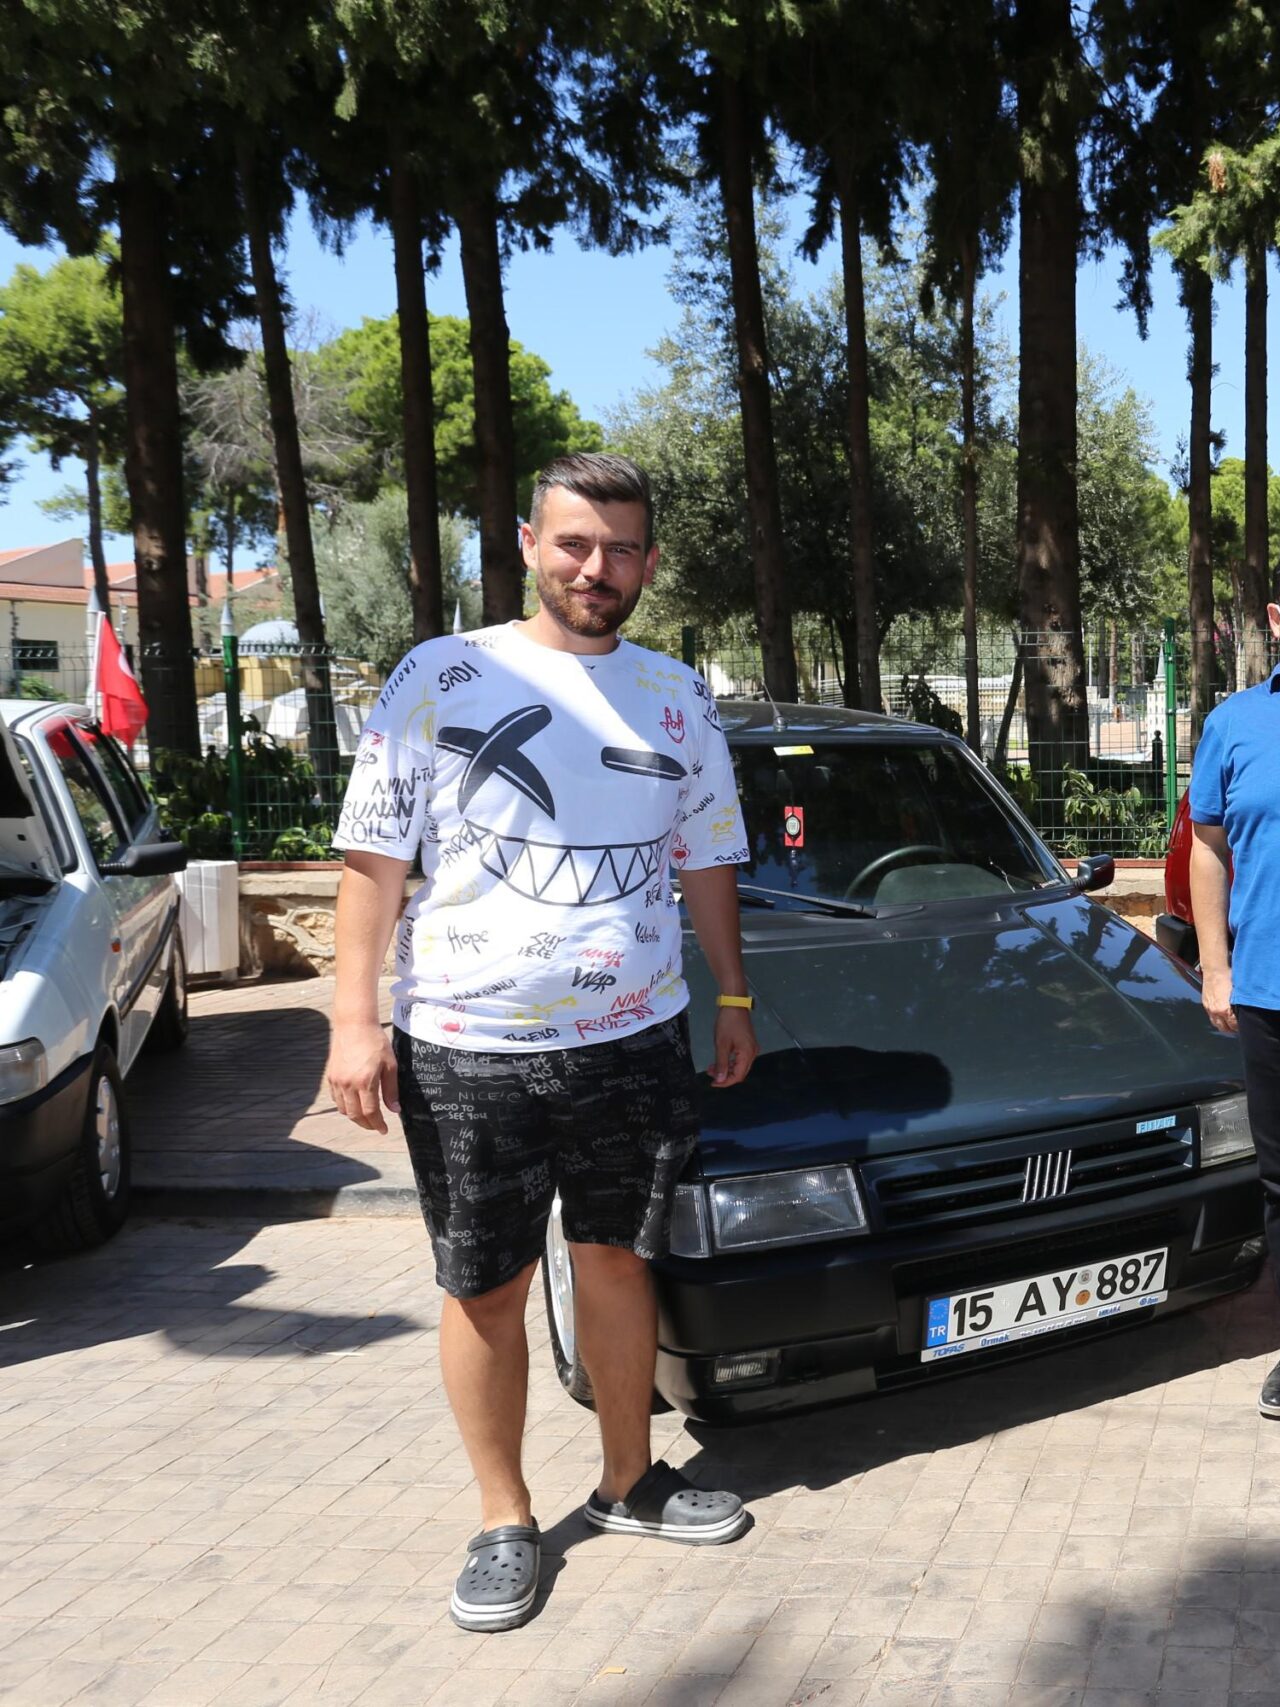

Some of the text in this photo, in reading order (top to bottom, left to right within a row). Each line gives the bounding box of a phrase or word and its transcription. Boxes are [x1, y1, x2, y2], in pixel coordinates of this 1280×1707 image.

[438, 660, 482, 692] SAD!
[447, 925, 489, 954] Hope
[527, 1079, 565, 1096] FEAR
[431, 1102, 474, 1112] GOOD TO
[448, 1112, 464, 1121] SEE
[930, 1325, 946, 1338] TR
[953, 1291, 994, 1337] 15
[1014, 1271, 1078, 1322] AY
[1096, 1251, 1165, 1301] 887
